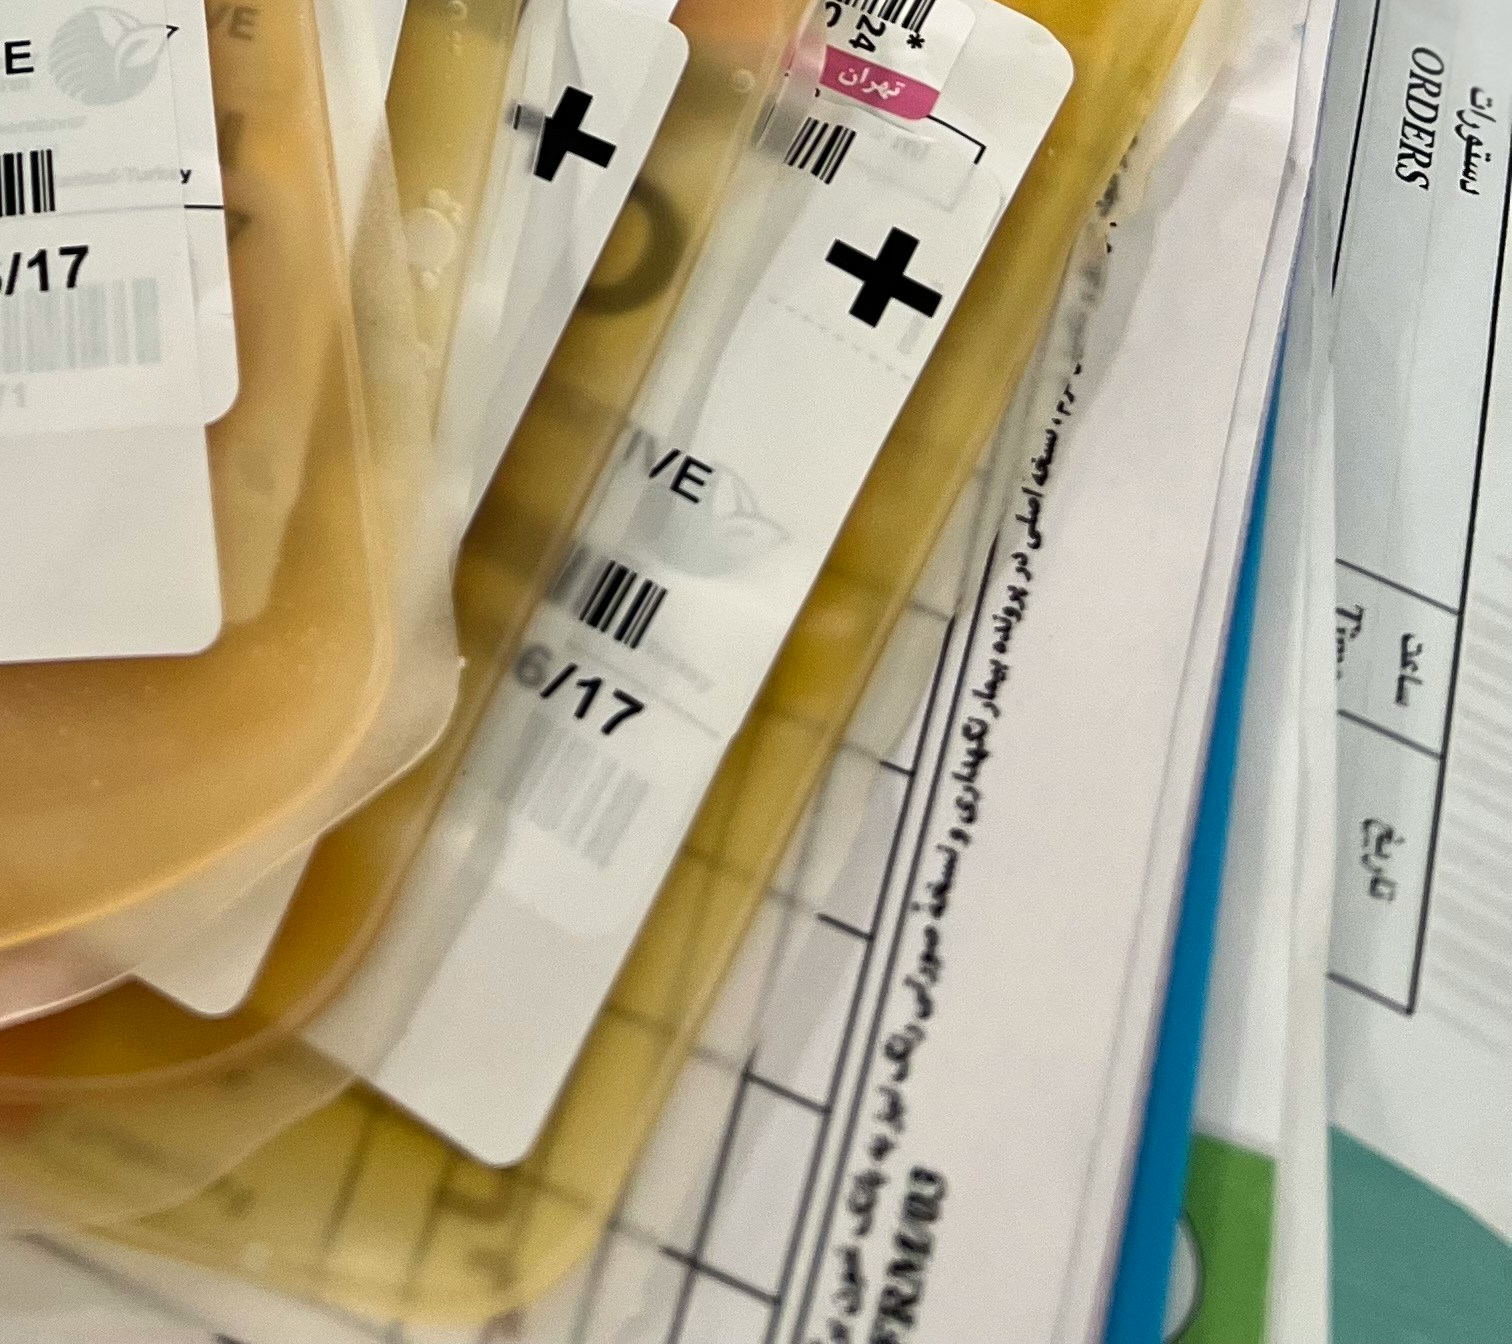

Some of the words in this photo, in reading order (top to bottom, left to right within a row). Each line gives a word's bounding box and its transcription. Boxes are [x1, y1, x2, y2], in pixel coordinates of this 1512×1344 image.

[837, 67, 907, 100] تهران
[1395, 46, 1445, 191] ORDERS
[1454, 86, 1497, 196] دستورات
